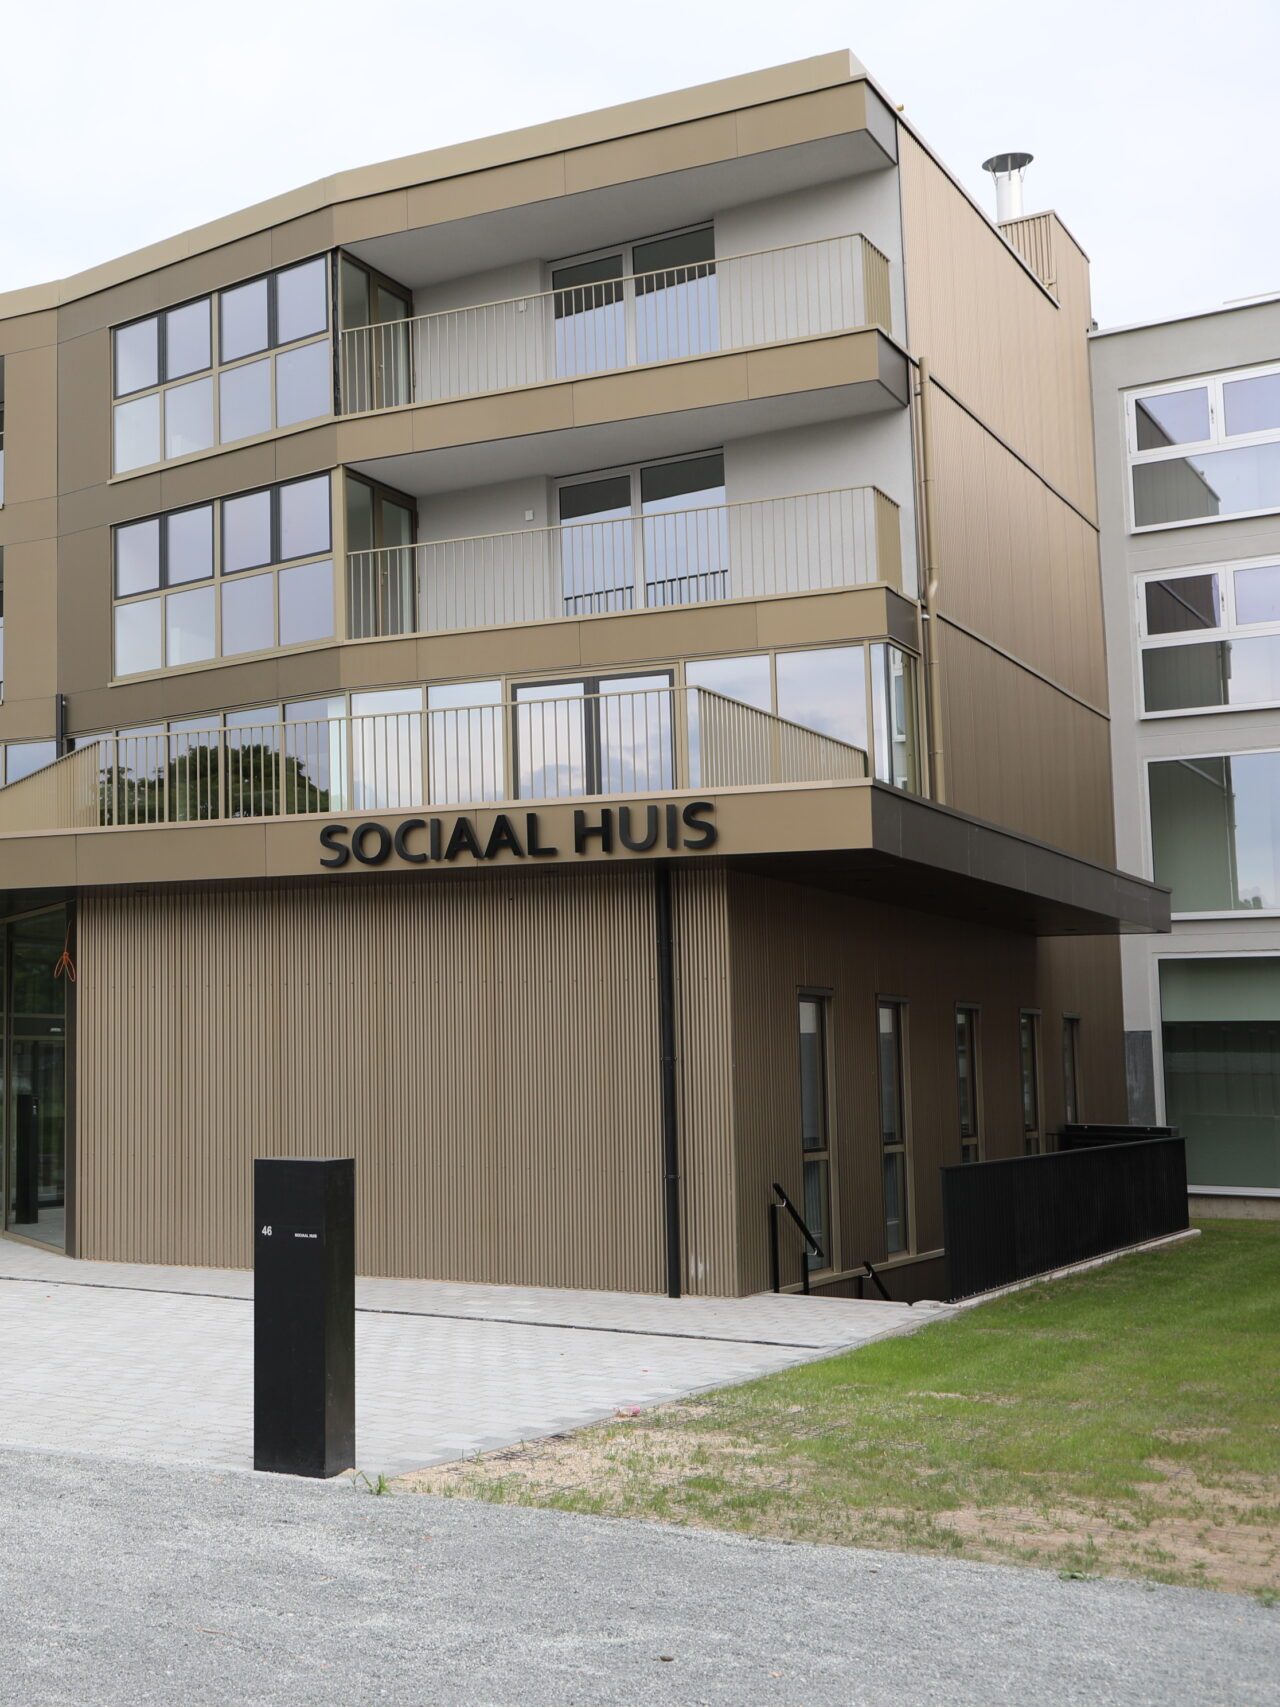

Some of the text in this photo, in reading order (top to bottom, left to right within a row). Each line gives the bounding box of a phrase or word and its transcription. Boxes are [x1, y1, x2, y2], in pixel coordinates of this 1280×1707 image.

[319, 801, 718, 868] SOCIAAL HUIS
[261, 1225, 273, 1236] 46
